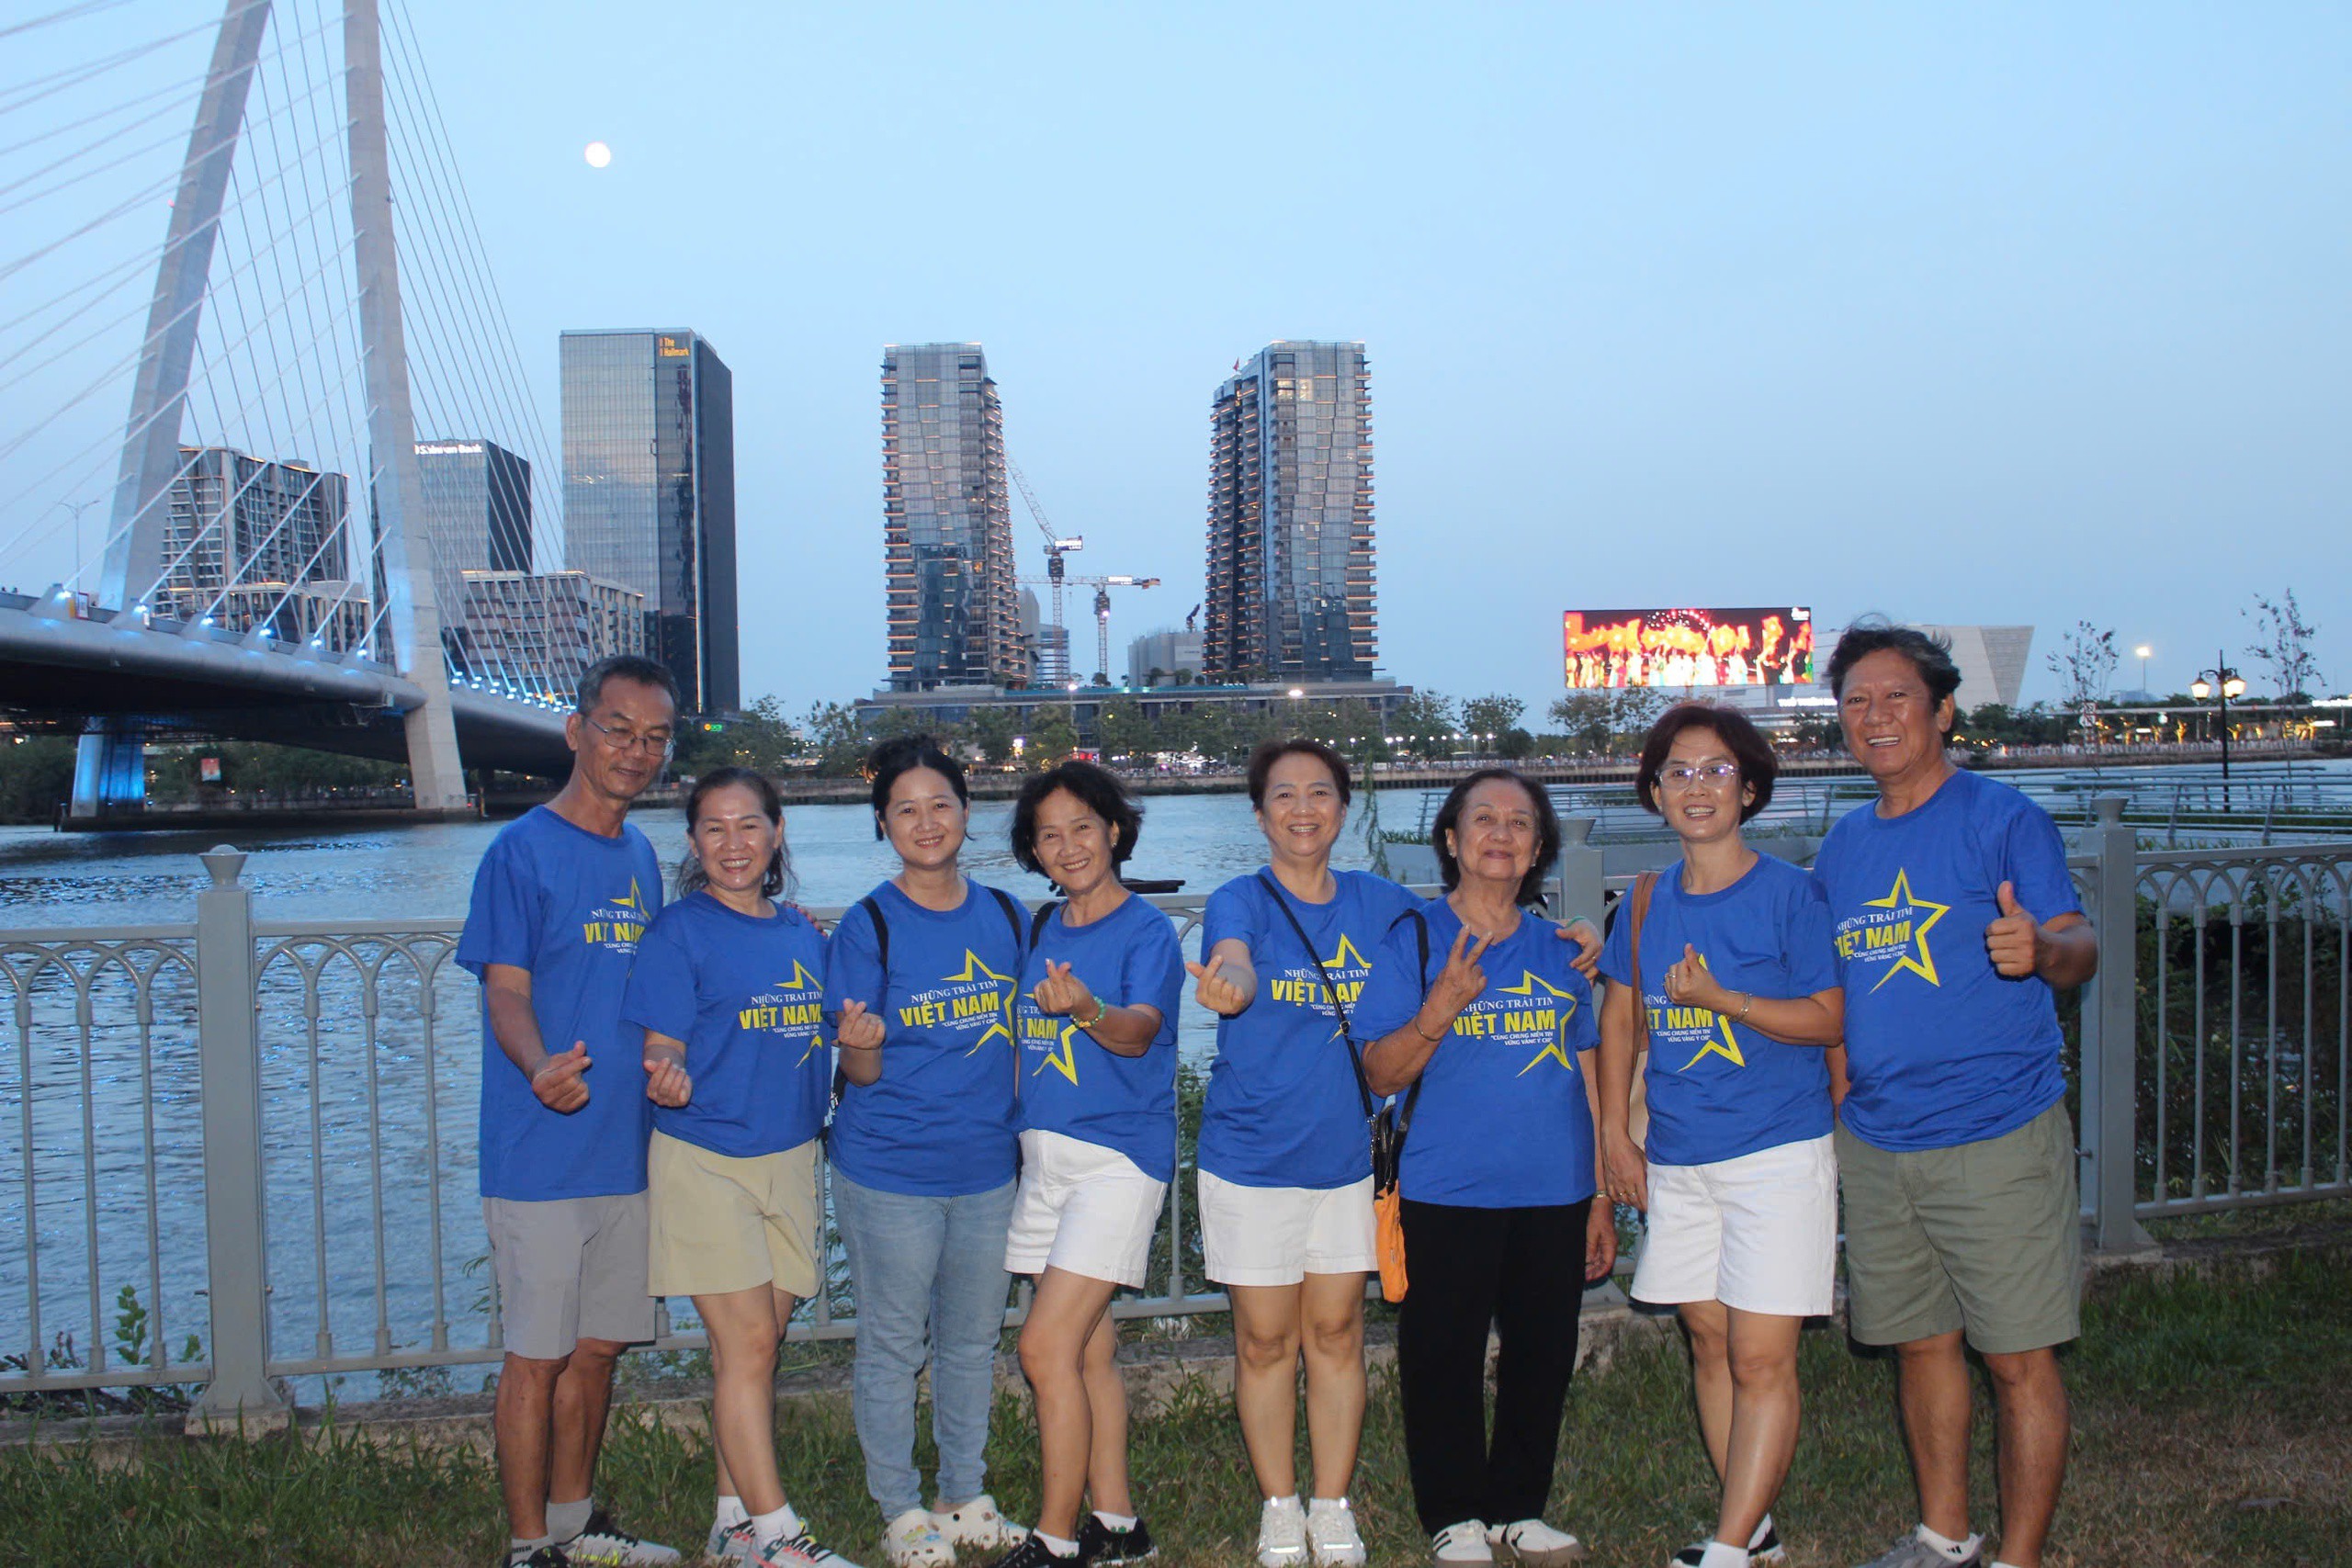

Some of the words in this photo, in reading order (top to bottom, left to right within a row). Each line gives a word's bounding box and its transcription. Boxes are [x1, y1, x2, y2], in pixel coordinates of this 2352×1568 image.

[458, 444, 482, 454] Bank
[1867, 909, 1895, 923] TRÁI
[1896, 907, 1914, 919] TIM
[1865, 920, 1911, 950] NAM
[1348, 968, 1369, 978] TIM
[911, 989, 951, 1003] NHỮNG
[951, 983, 977, 995] TRÁI
[978, 980, 998, 990] TIM
[1272, 977, 1317, 1007] VIỆT
[1506, 997, 1533, 1008] TRÁI
[739, 1004, 777, 1032] VIỆT
[783, 1004, 822, 1026] NAM
[899, 1000, 945, 1029] VIỆT
[953, 991, 999, 1019] NAM
[1667, 1007, 1713, 1029] NAM
[1026, 1018, 1058, 1040] NAM
[1453, 1011, 1497, 1040] VIỆT
[1504, 1010, 1555, 1032] NAM
